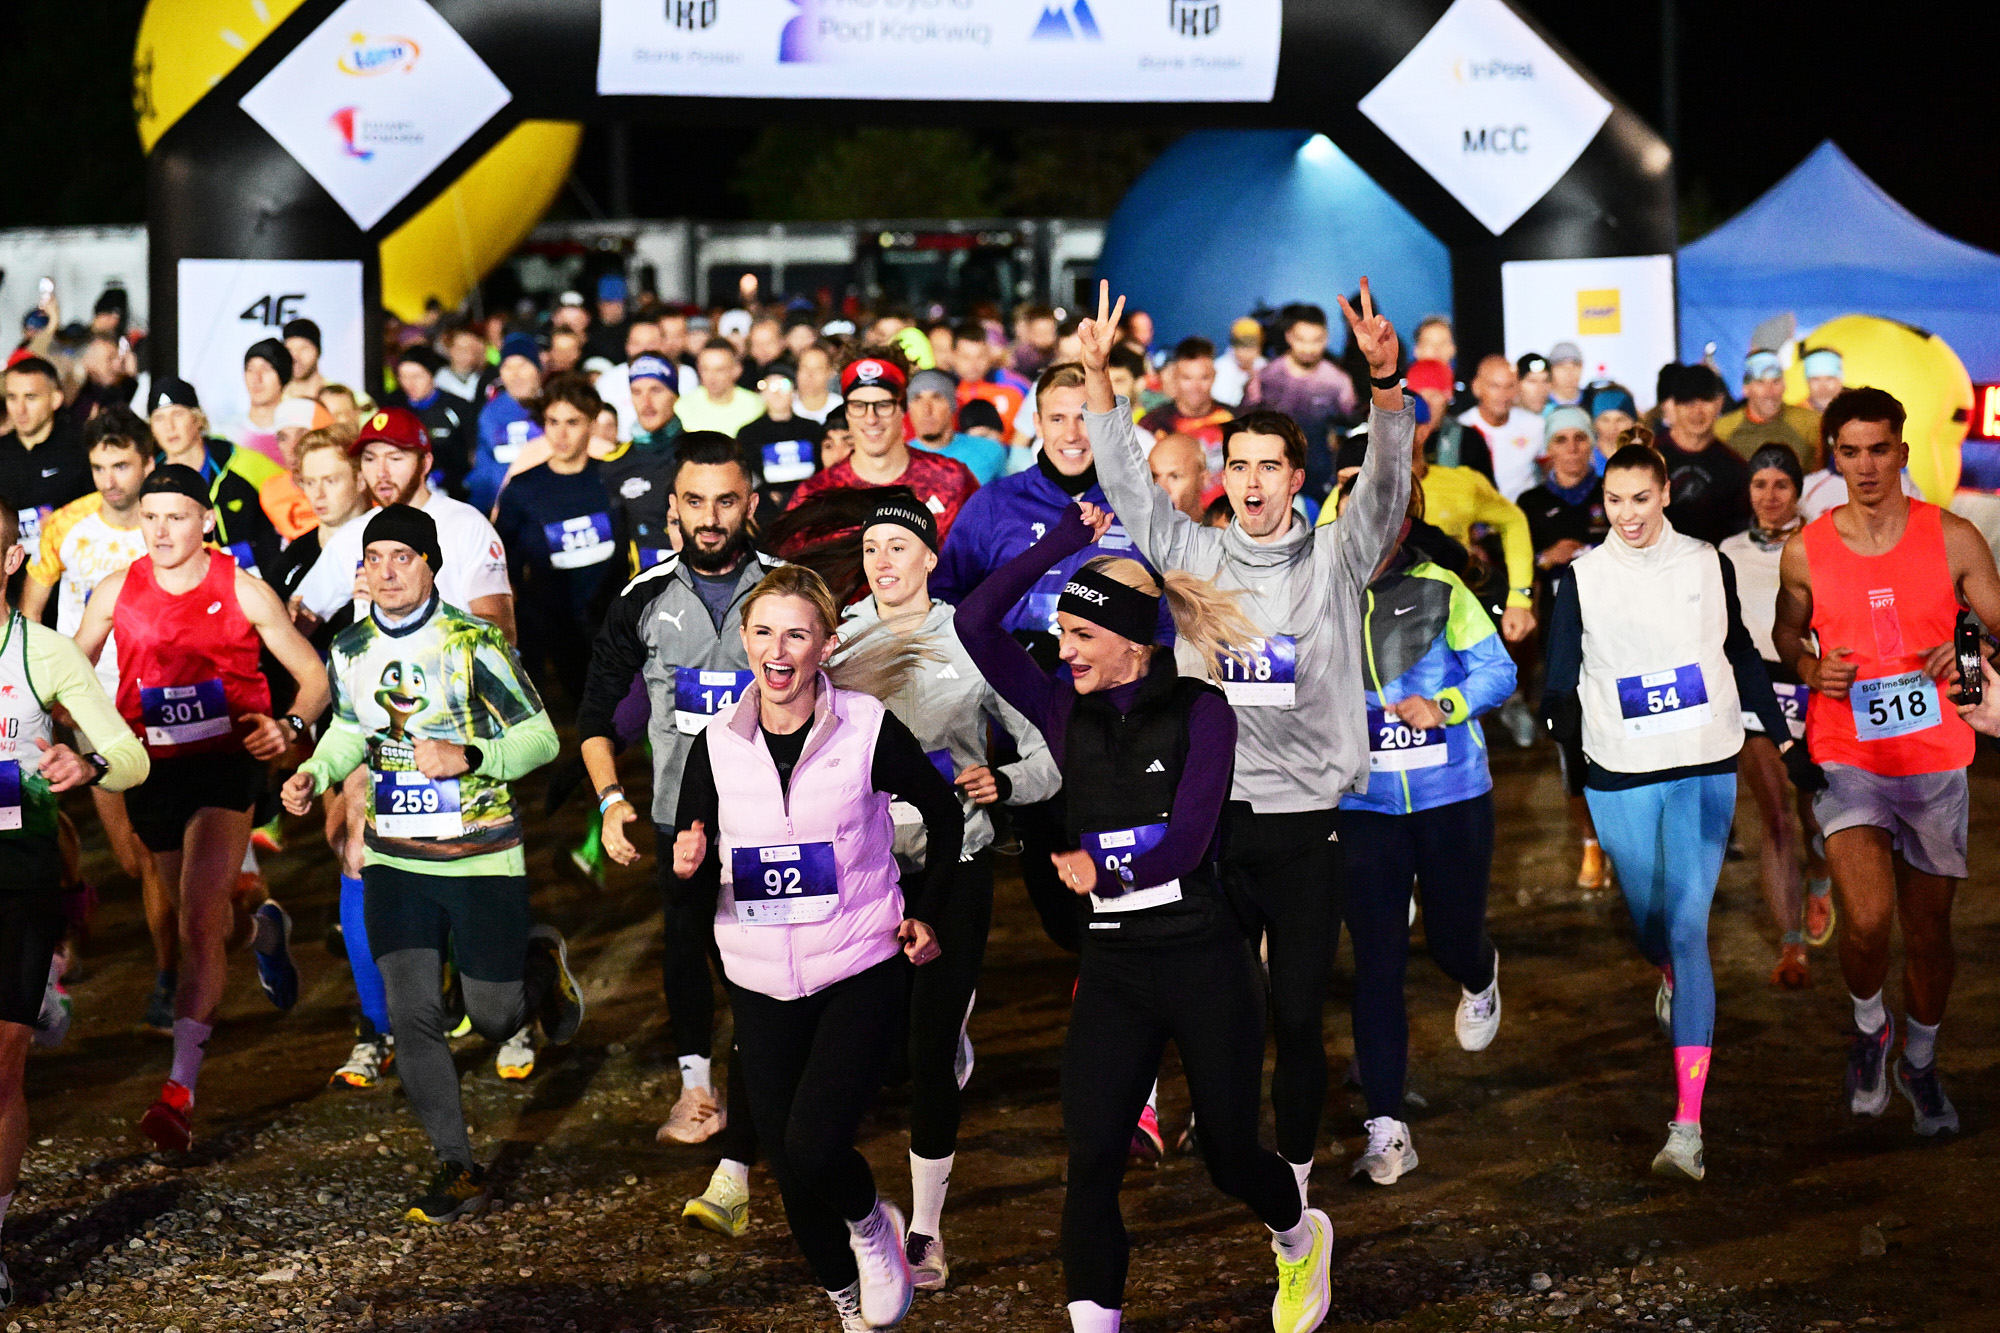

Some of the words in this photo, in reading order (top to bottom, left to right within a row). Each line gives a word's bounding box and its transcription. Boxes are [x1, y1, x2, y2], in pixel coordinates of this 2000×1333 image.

[1462, 126, 1529, 154] MCC
[876, 506, 929, 530] RUNNING
[1224, 656, 1272, 681] 118
[161, 700, 206, 724] 301
[1647, 686, 1681, 713] 54
[1868, 691, 1927, 726] 518
[1380, 725, 1427, 750] 209
[391, 788, 439, 813] 259
[764, 867, 803, 896] 92
